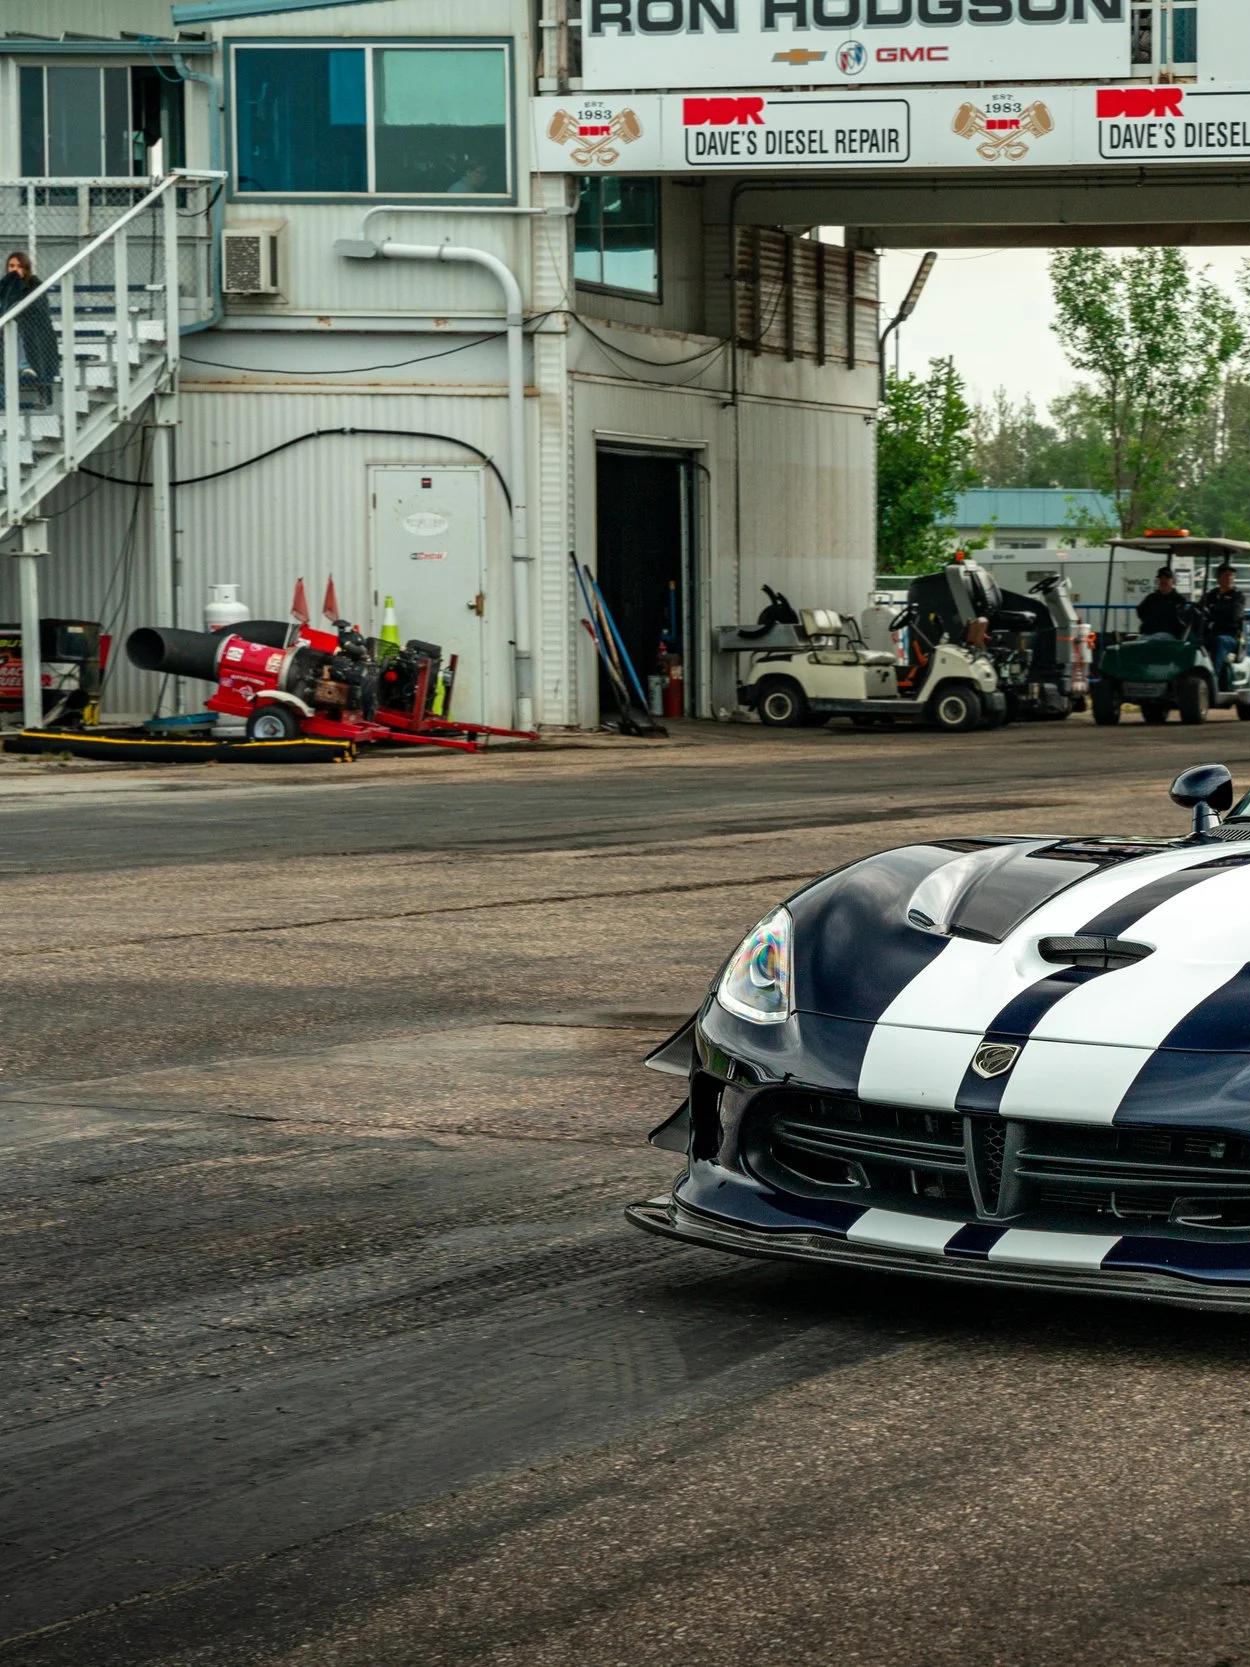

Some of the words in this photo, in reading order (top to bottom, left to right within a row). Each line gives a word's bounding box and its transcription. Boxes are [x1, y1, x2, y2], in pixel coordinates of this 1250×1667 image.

[587, 0, 740, 38] RON
[760, 0, 1127, 33] HODGSON
[875, 46, 949, 63] GMC
[577, 110, 612, 120] 1983
[683, 97, 764, 126] DDR
[985, 103, 1022, 113] 1983
[1096, 88, 1183, 118] DDR
[695, 130, 758, 156] DAVE'S
[765, 129, 829, 155] DIESEL
[834, 128, 900, 154] REPAIR
[1109, 122, 1176, 150] DAVE'S
